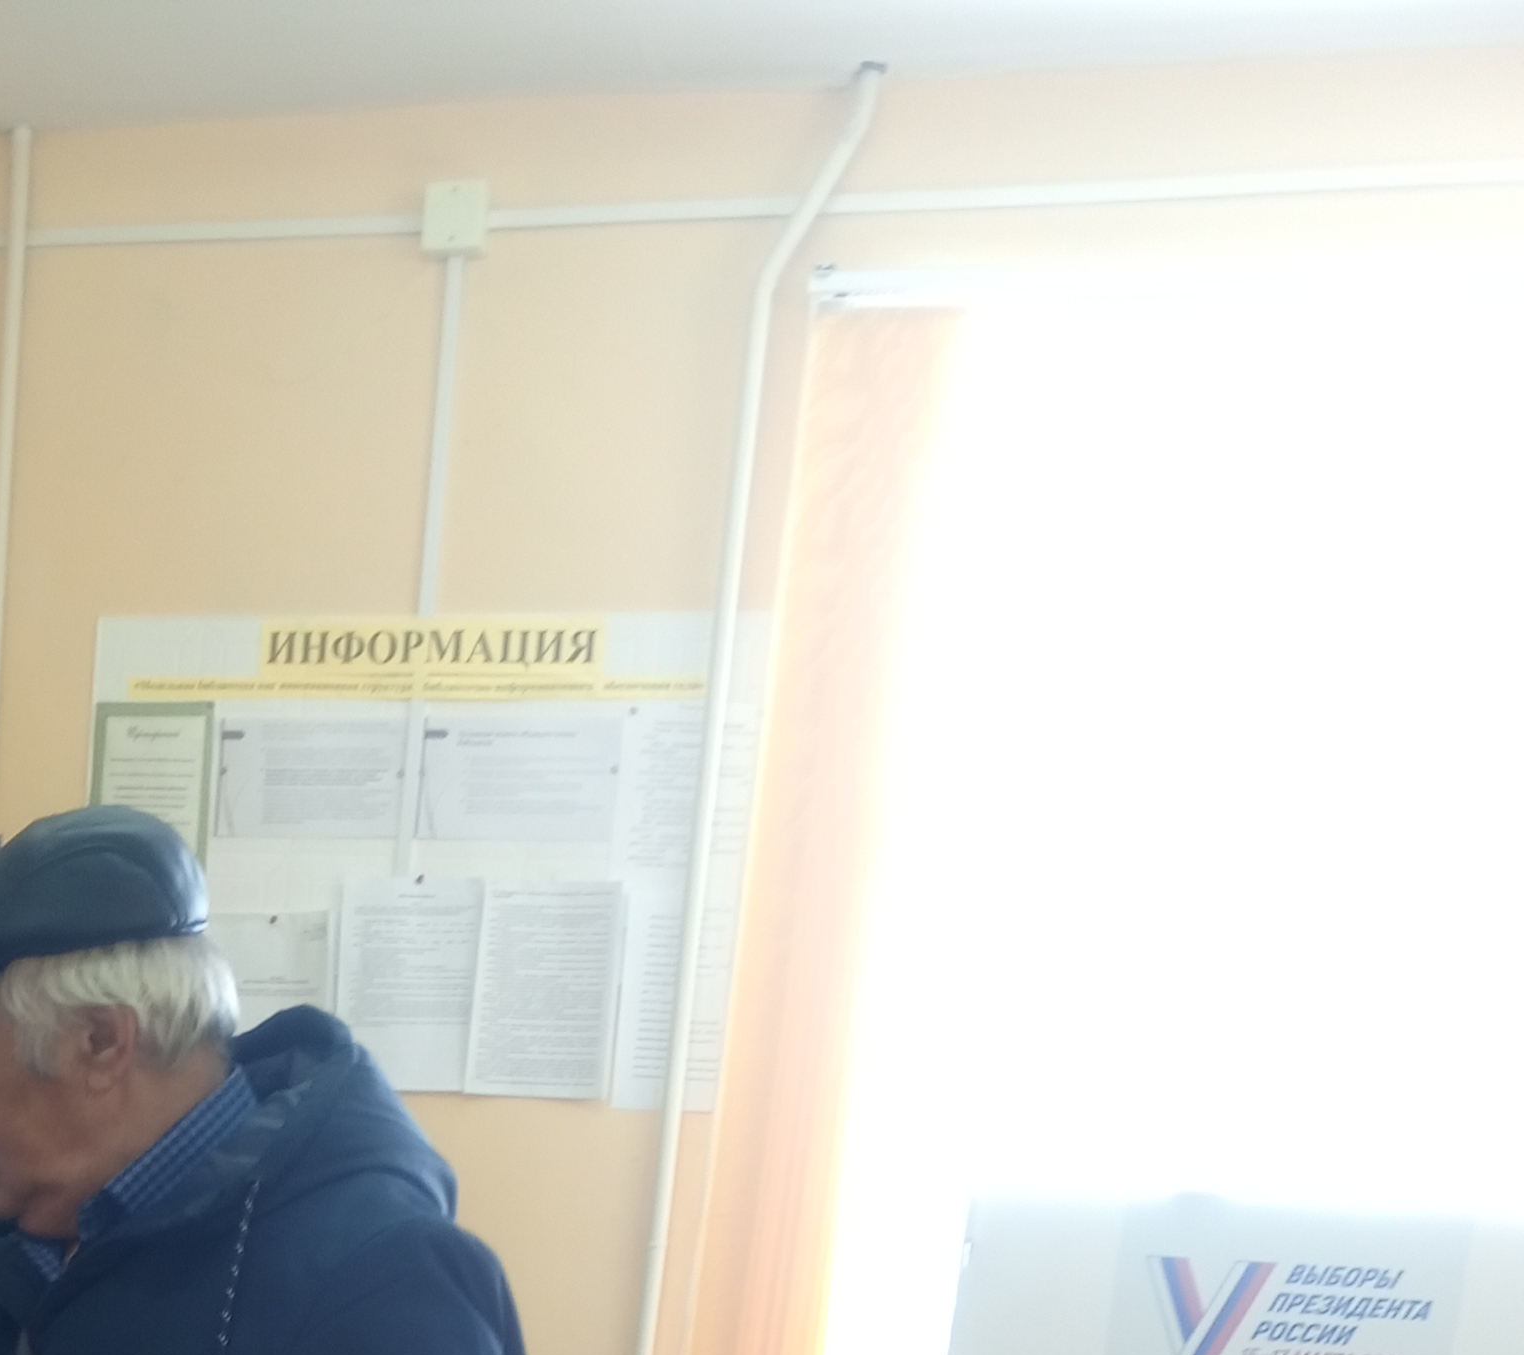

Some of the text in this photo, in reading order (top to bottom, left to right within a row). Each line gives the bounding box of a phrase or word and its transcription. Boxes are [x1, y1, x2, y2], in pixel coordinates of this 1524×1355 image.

[266, 628, 600, 667] ИНФОРМАЦИЯ
[1285, 1263, 1405, 1290] ВЫБОРЫ
[1266, 1292, 1434, 1323] ПРЕЗИДЕНТА
[1250, 1320, 1358, 1346] РОССИИ
